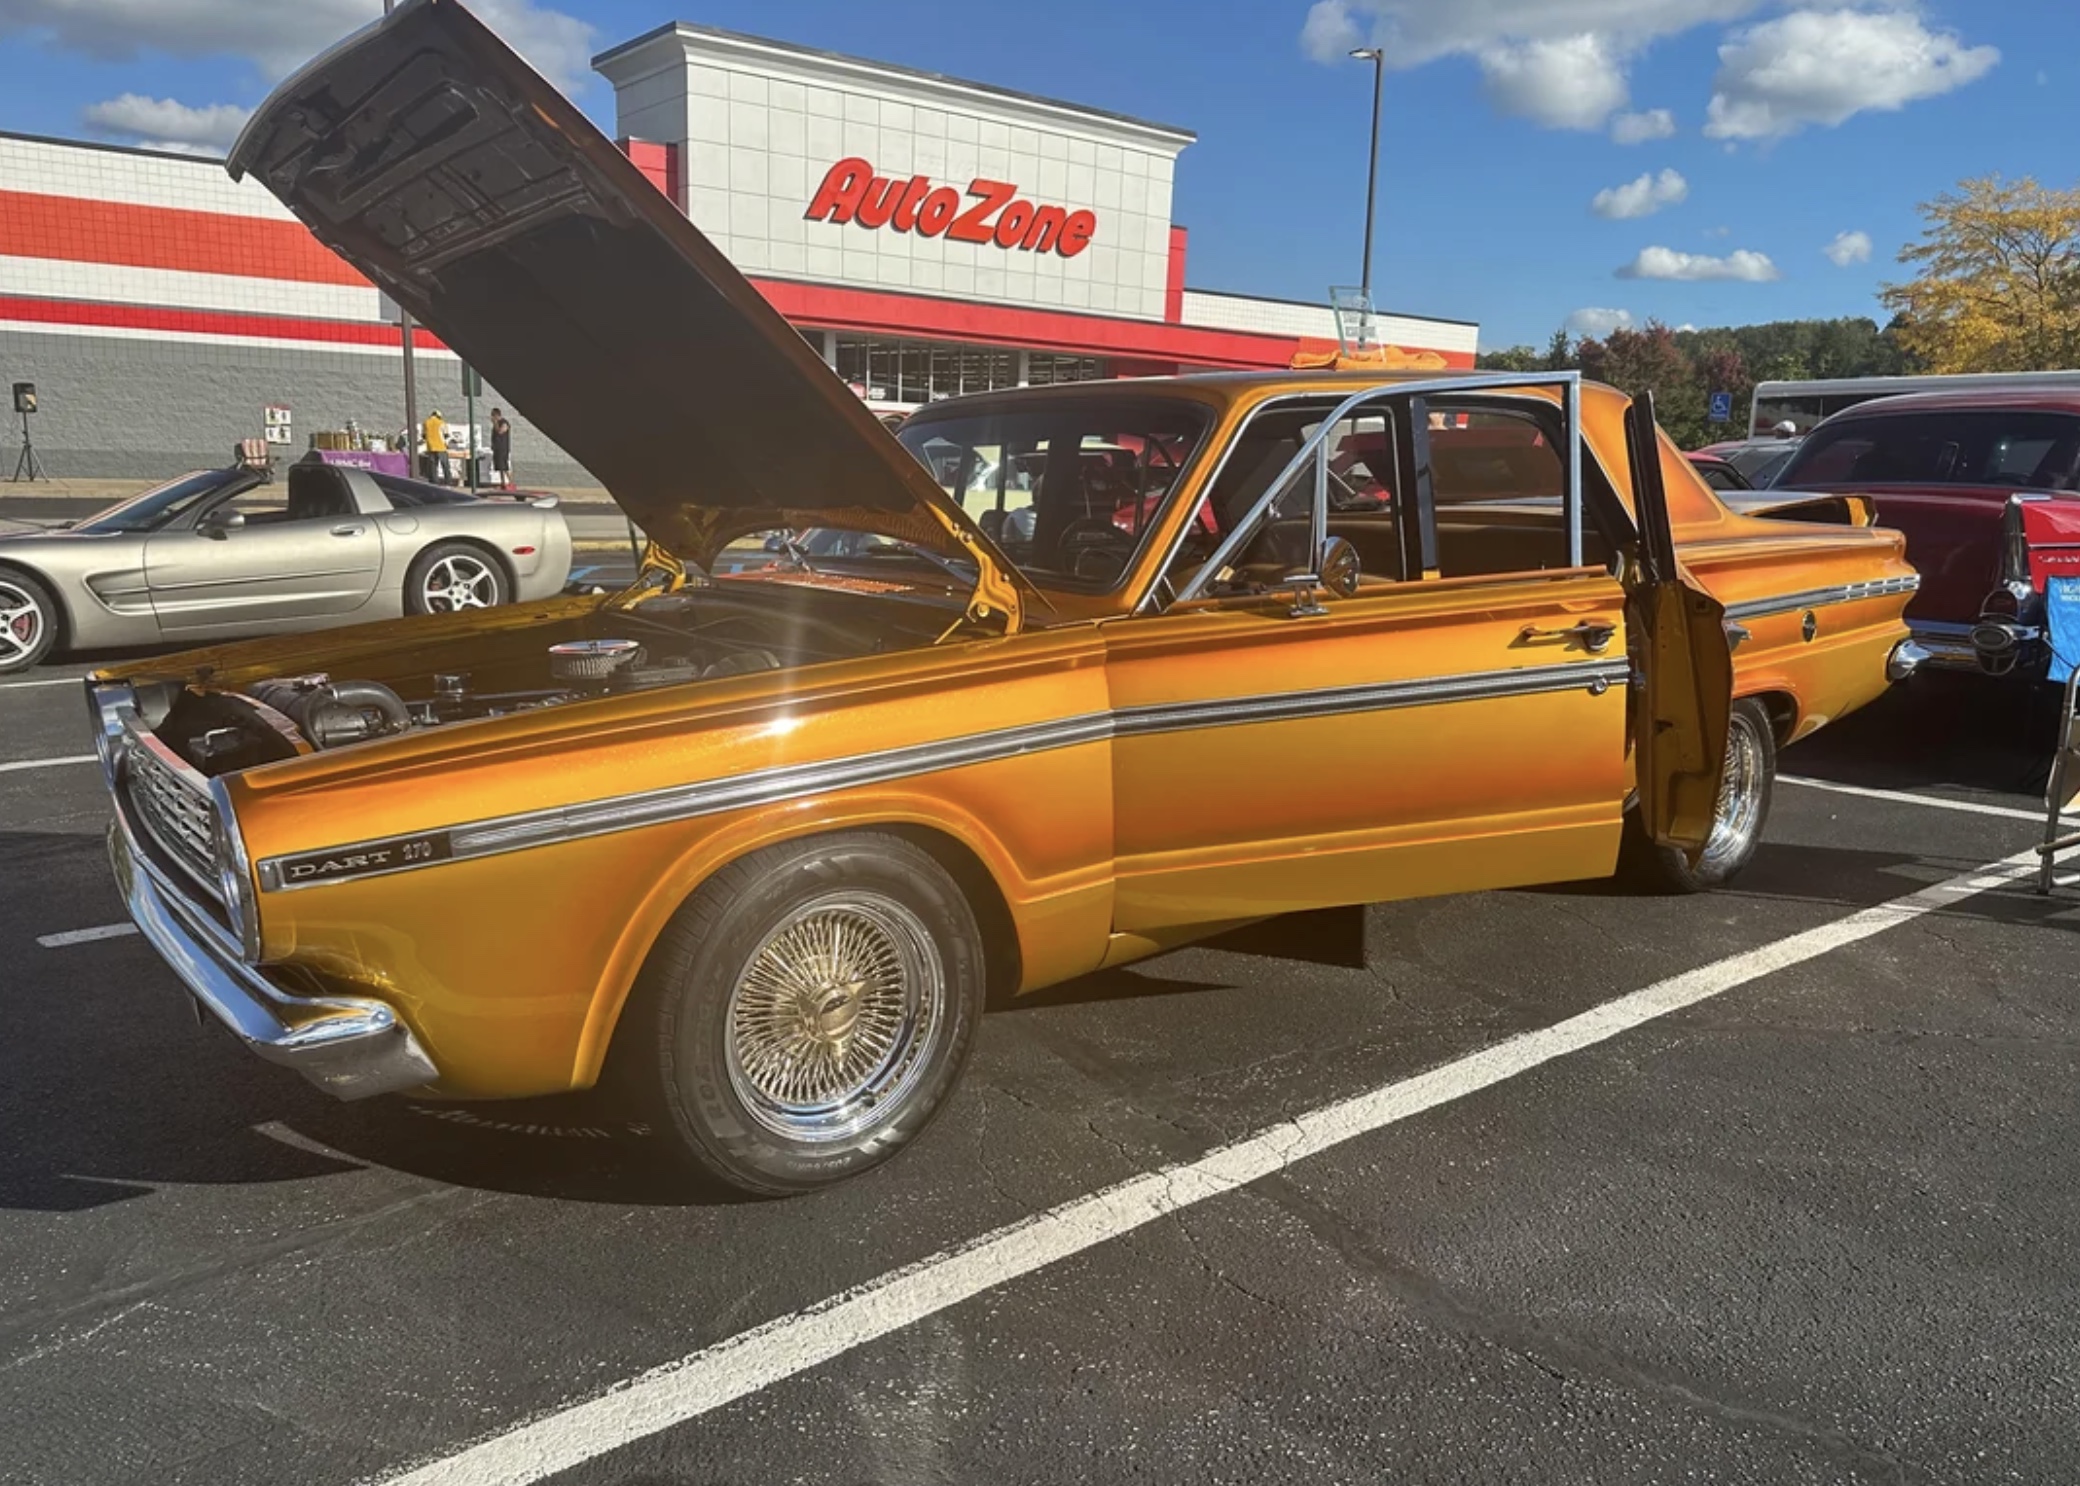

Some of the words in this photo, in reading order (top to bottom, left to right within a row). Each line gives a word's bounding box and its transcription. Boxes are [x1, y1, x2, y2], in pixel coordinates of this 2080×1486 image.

[803, 156, 1096, 259] AutoZone
[291, 851, 391, 878] DART
[403, 842, 431, 860] 270
